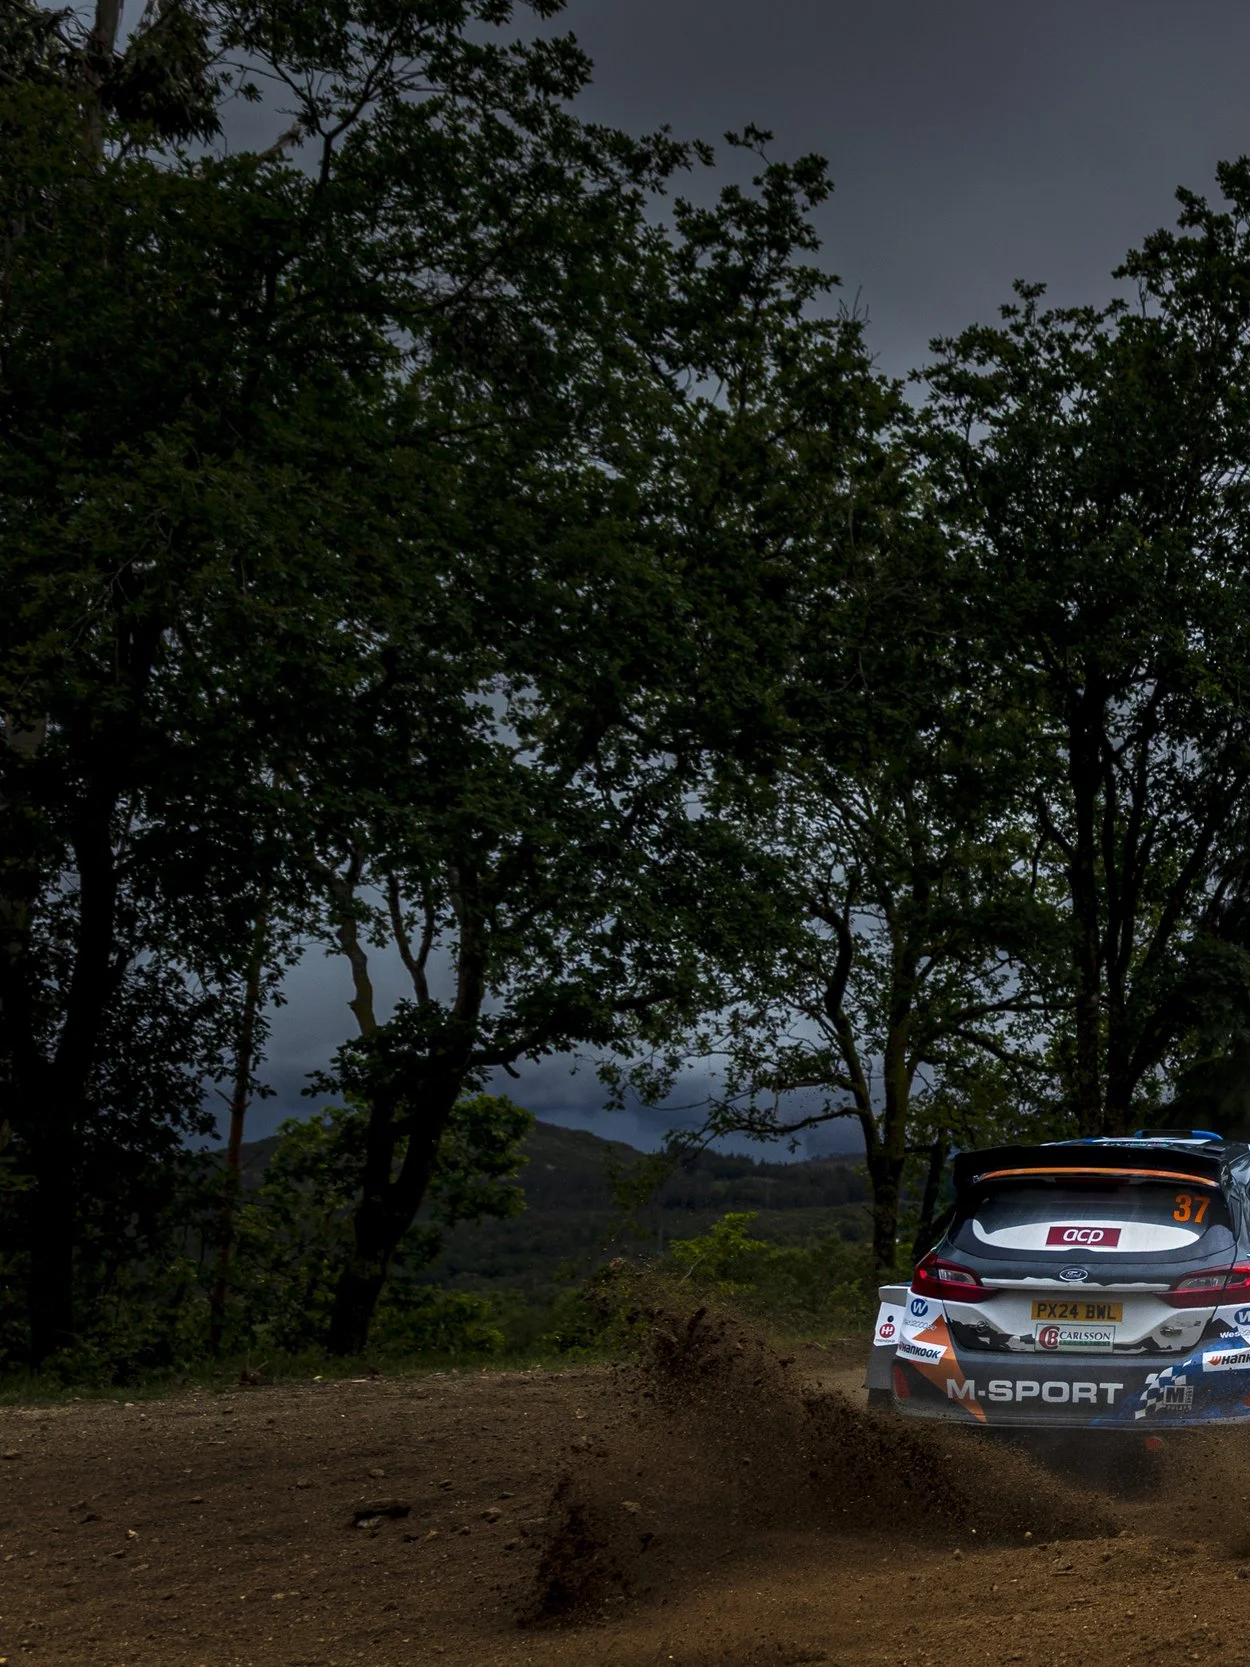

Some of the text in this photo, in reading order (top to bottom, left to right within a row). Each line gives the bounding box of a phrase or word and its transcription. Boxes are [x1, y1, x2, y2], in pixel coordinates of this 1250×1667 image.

[1172, 1194, 1211, 1223] 37
[1062, 1229, 1105, 1244] acp
[1037, 1303, 1117, 1320] PX24 BWL
[1060, 1331, 1111, 1341] CARLSSON
[947, 1379, 1124, 1404] M-SPORT
